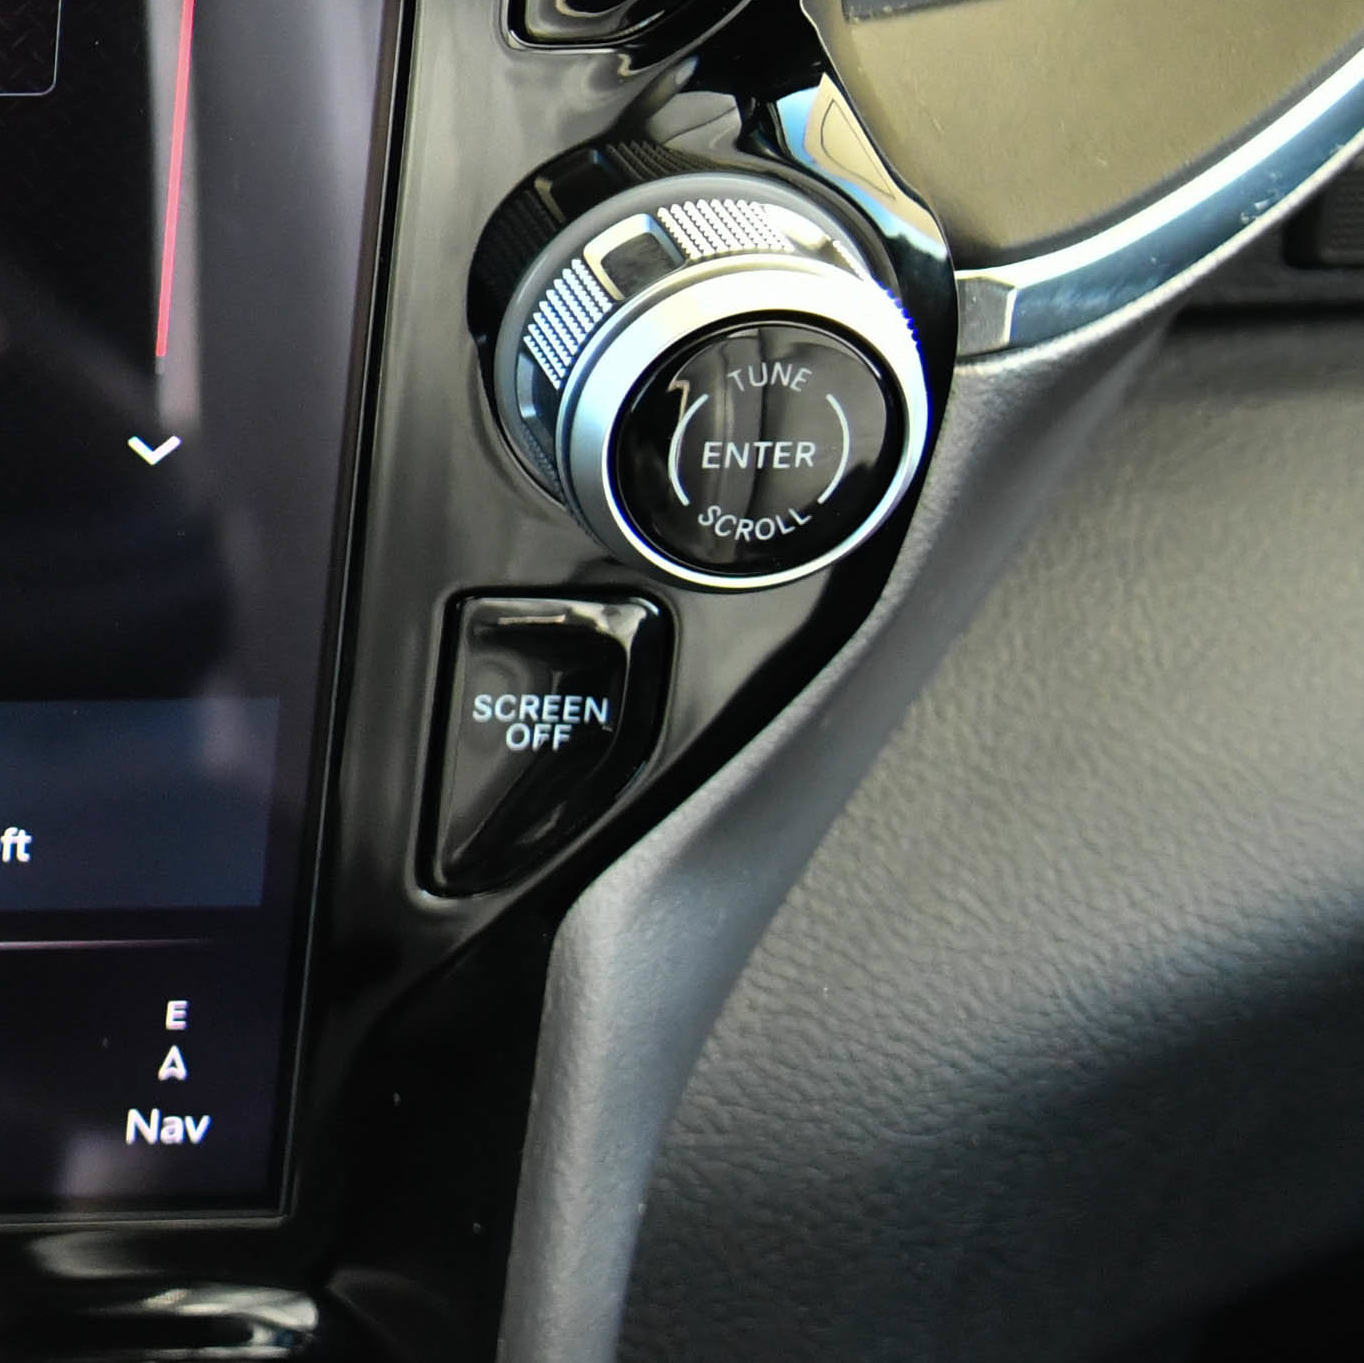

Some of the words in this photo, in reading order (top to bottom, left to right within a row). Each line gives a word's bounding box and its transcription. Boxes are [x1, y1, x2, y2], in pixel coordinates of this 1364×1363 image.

[728, 362, 812, 393] TUNE
[702, 440, 817, 470] ENTER
[698, 505, 812, 541] SCROLL
[472, 694, 609, 724] SCREEN
[505, 724, 572, 752] OFF
[125, 1108, 210, 1145] Nav
